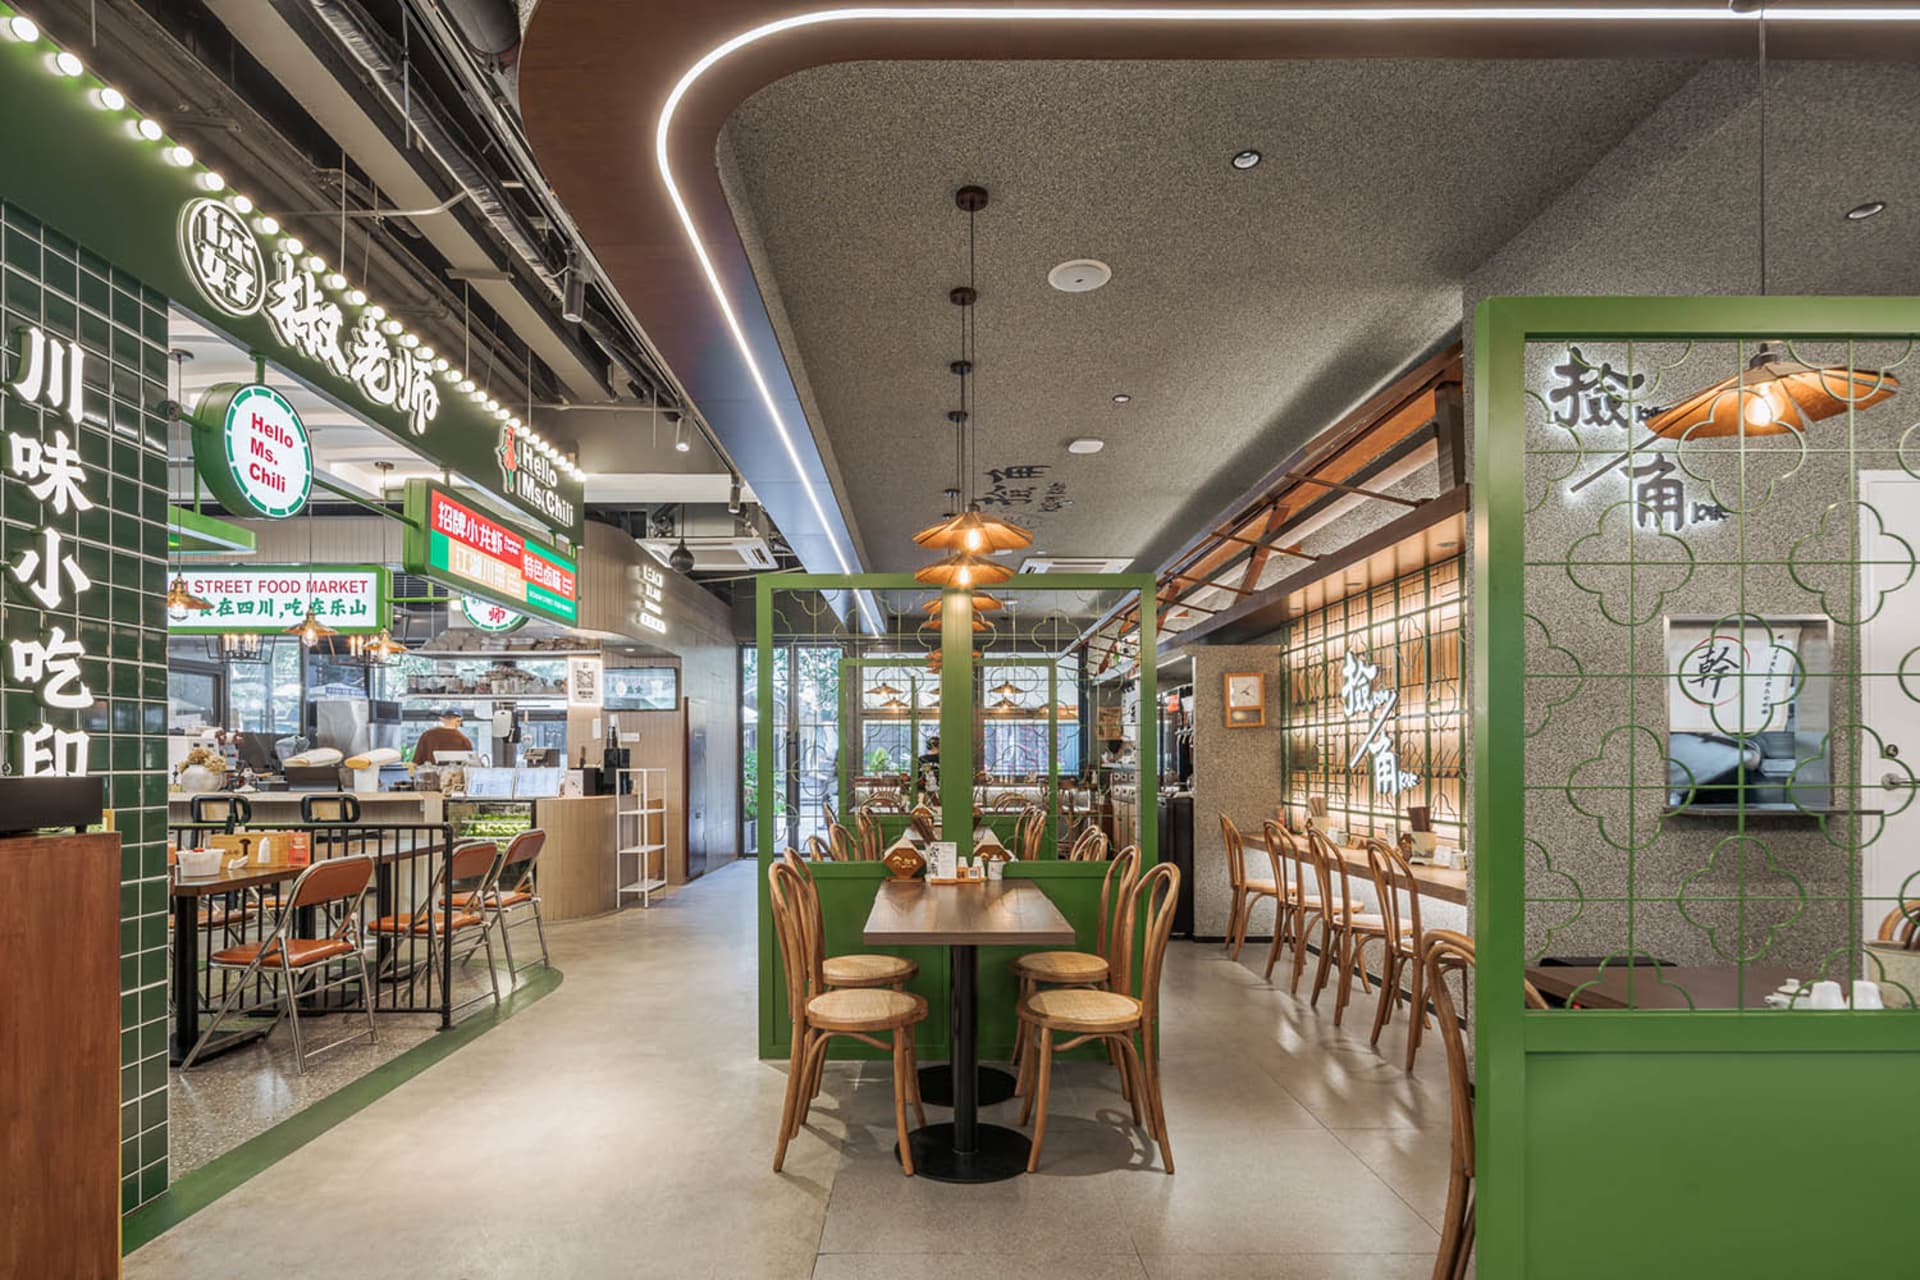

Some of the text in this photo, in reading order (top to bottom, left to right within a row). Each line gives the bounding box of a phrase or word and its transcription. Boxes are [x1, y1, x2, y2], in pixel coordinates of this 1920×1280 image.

[251, 412, 294, 449] Hello
[250, 437, 278, 466] Ms.
[522, 444, 558, 487] Hello
[249, 462, 286, 493] Chili
[437, 501, 503, 555] 招牌小龙虾
[194, 579, 253, 593] STREET
[258, 579, 301, 593] FOOD
[306, 579, 368, 593] MARKET
